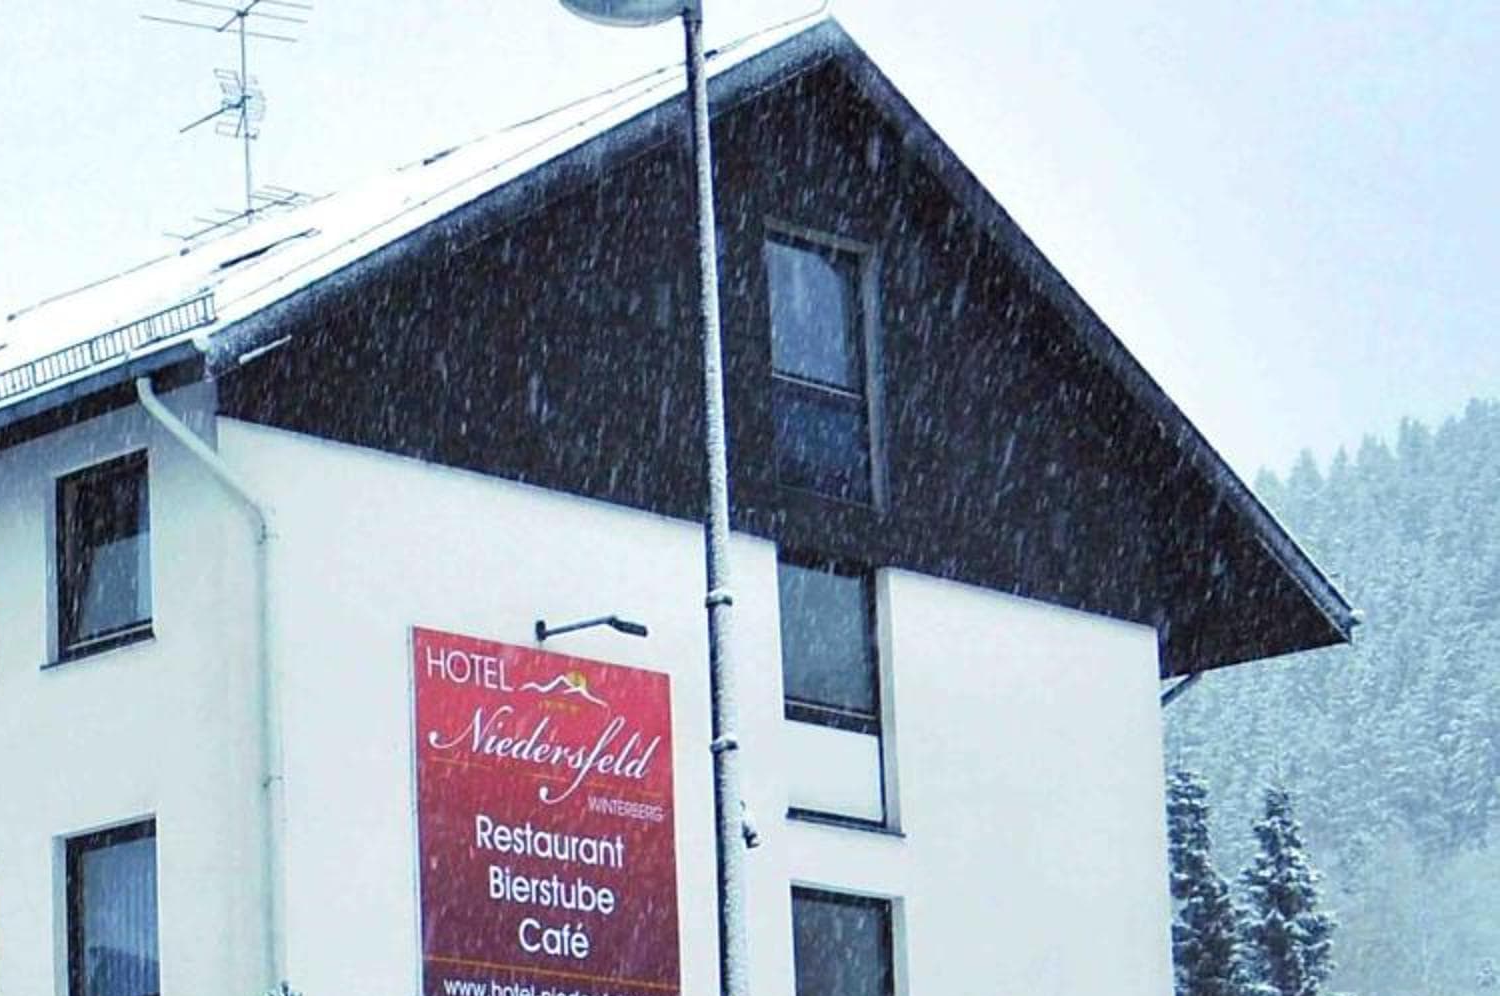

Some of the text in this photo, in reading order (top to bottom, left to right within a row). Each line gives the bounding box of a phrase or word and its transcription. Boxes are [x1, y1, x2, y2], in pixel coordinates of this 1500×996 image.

[426, 647, 514, 692] HOTEL
[428, 706, 660, 804] Niedersfeld
[587, 795, 664, 822] WINTERBERG
[476, 815, 624, 869] Restaurant
[488, 865, 615, 914] Bierstube
[518, 918, 589, 959] Café
